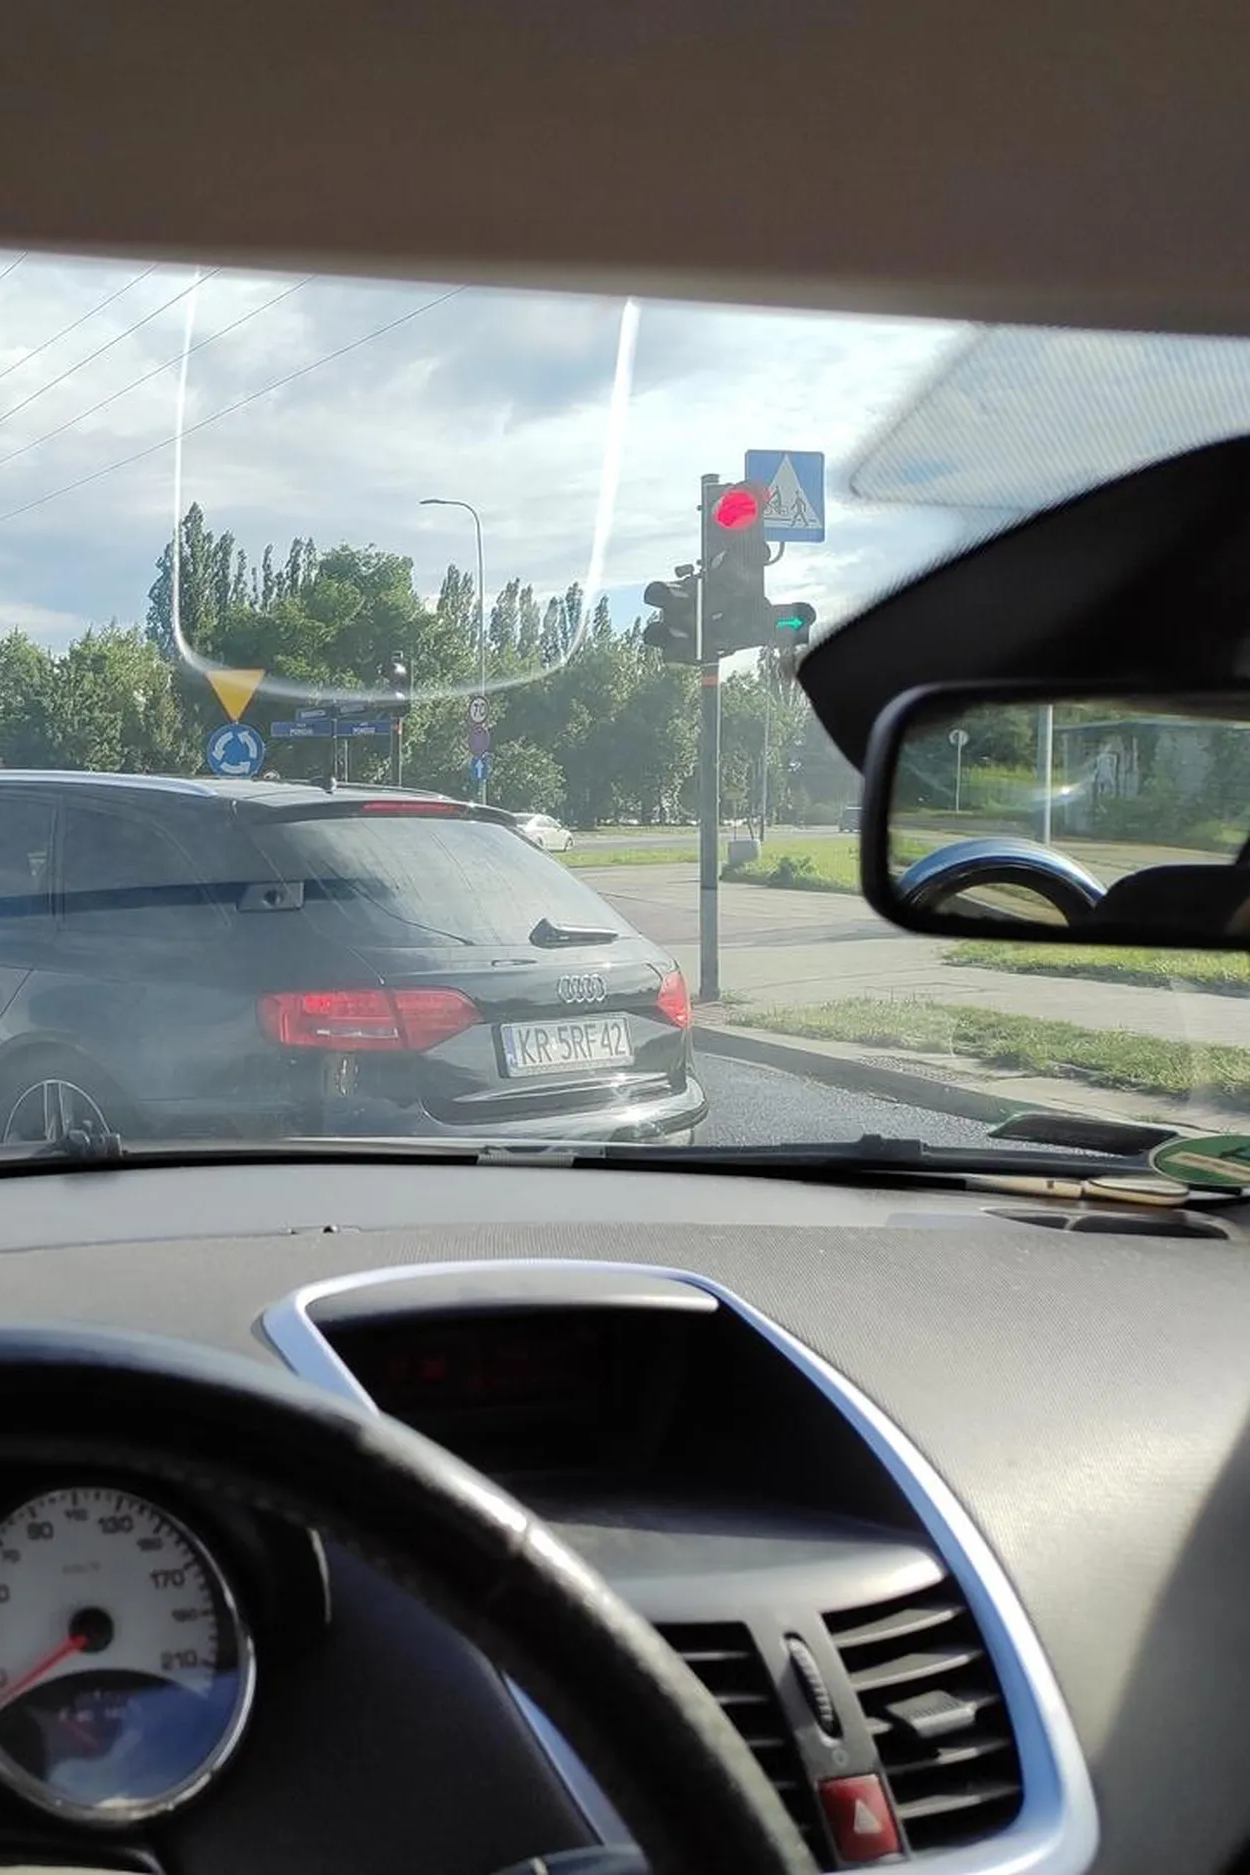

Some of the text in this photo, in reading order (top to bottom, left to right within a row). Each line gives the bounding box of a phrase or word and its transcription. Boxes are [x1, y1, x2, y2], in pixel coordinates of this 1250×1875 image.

[518, 1021, 626, 1065] KR 5RF42
[98, 1515, 134, 1534] 130
[150, 1569, 186, 1589] 170
[160, 1651, 198, 1670] 210
